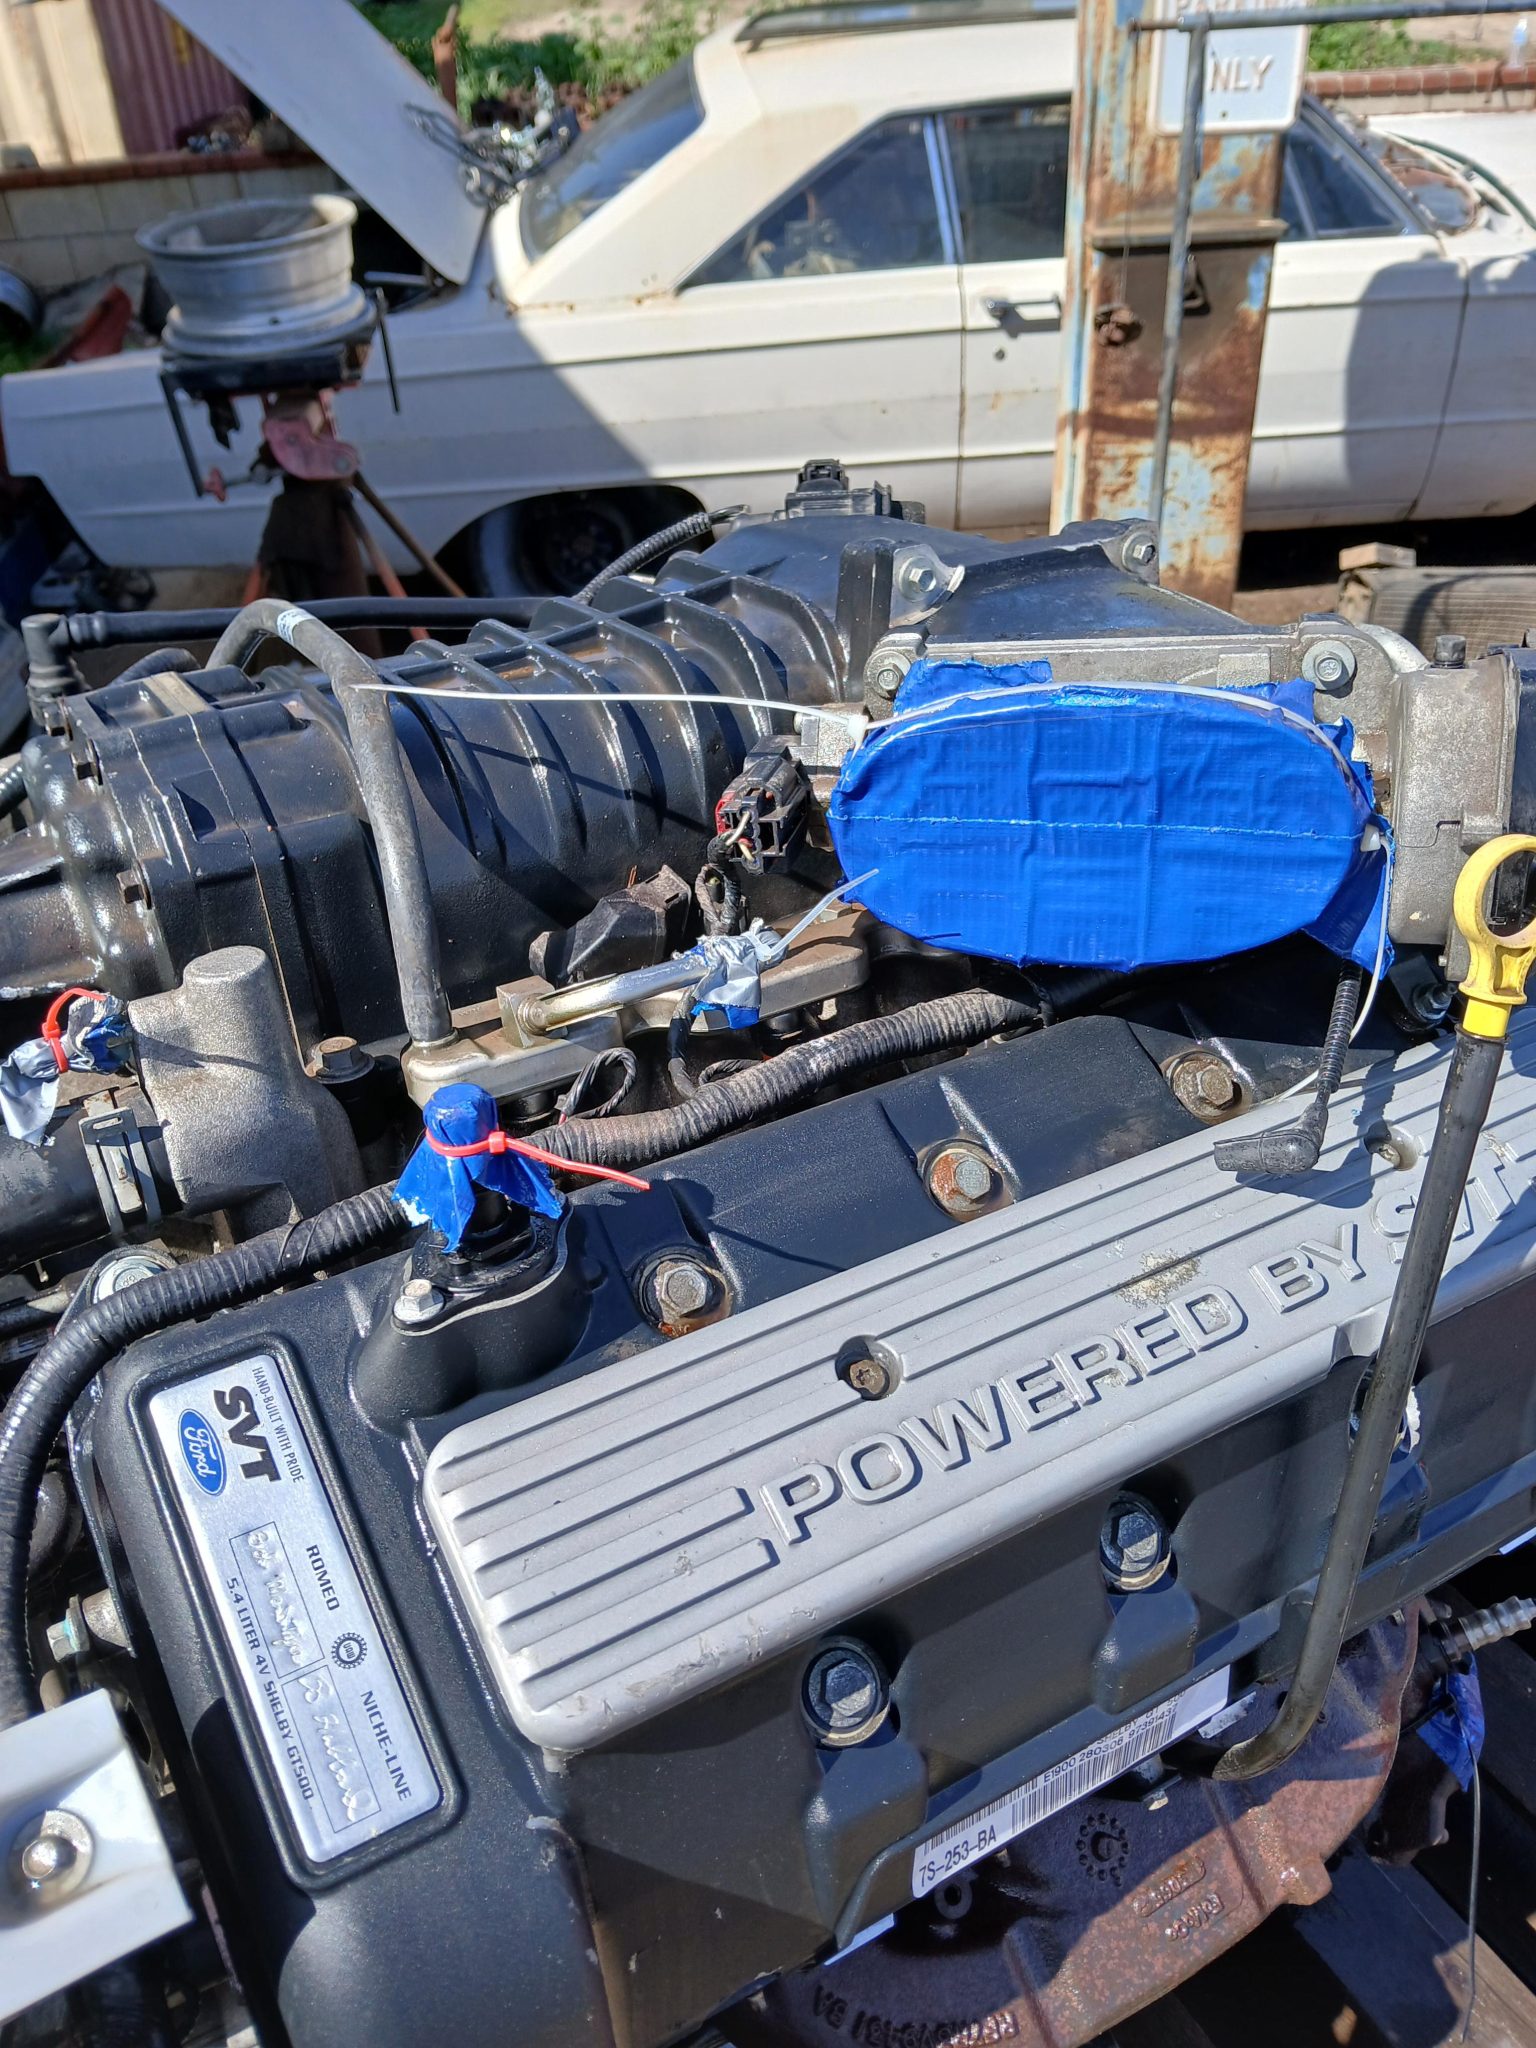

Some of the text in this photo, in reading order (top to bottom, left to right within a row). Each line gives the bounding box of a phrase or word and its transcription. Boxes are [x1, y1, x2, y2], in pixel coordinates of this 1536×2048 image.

[1207, 54, 1274, 92] NLY
[214, 1385, 281, 1482] SVT
[252, 1366, 304, 1483] HAND-BUILT WITH PRIDE
[759, 1284, 1248, 1546] POWERED
[1248, 1221, 1367, 1315] BY
[306, 1544, 340, 1611] ROMEO
[226, 1577, 244, 1604] 5.4
[237, 1607, 261, 1650] LITER
[255, 1654, 271, 1675] 4V
[264, 1680, 294, 1740] SHELBY
[286, 1745, 314, 1800] GT500
[361, 1690, 412, 1801] NICHE-LINE
[919, 1824, 997, 1887] 7S-253-BA
